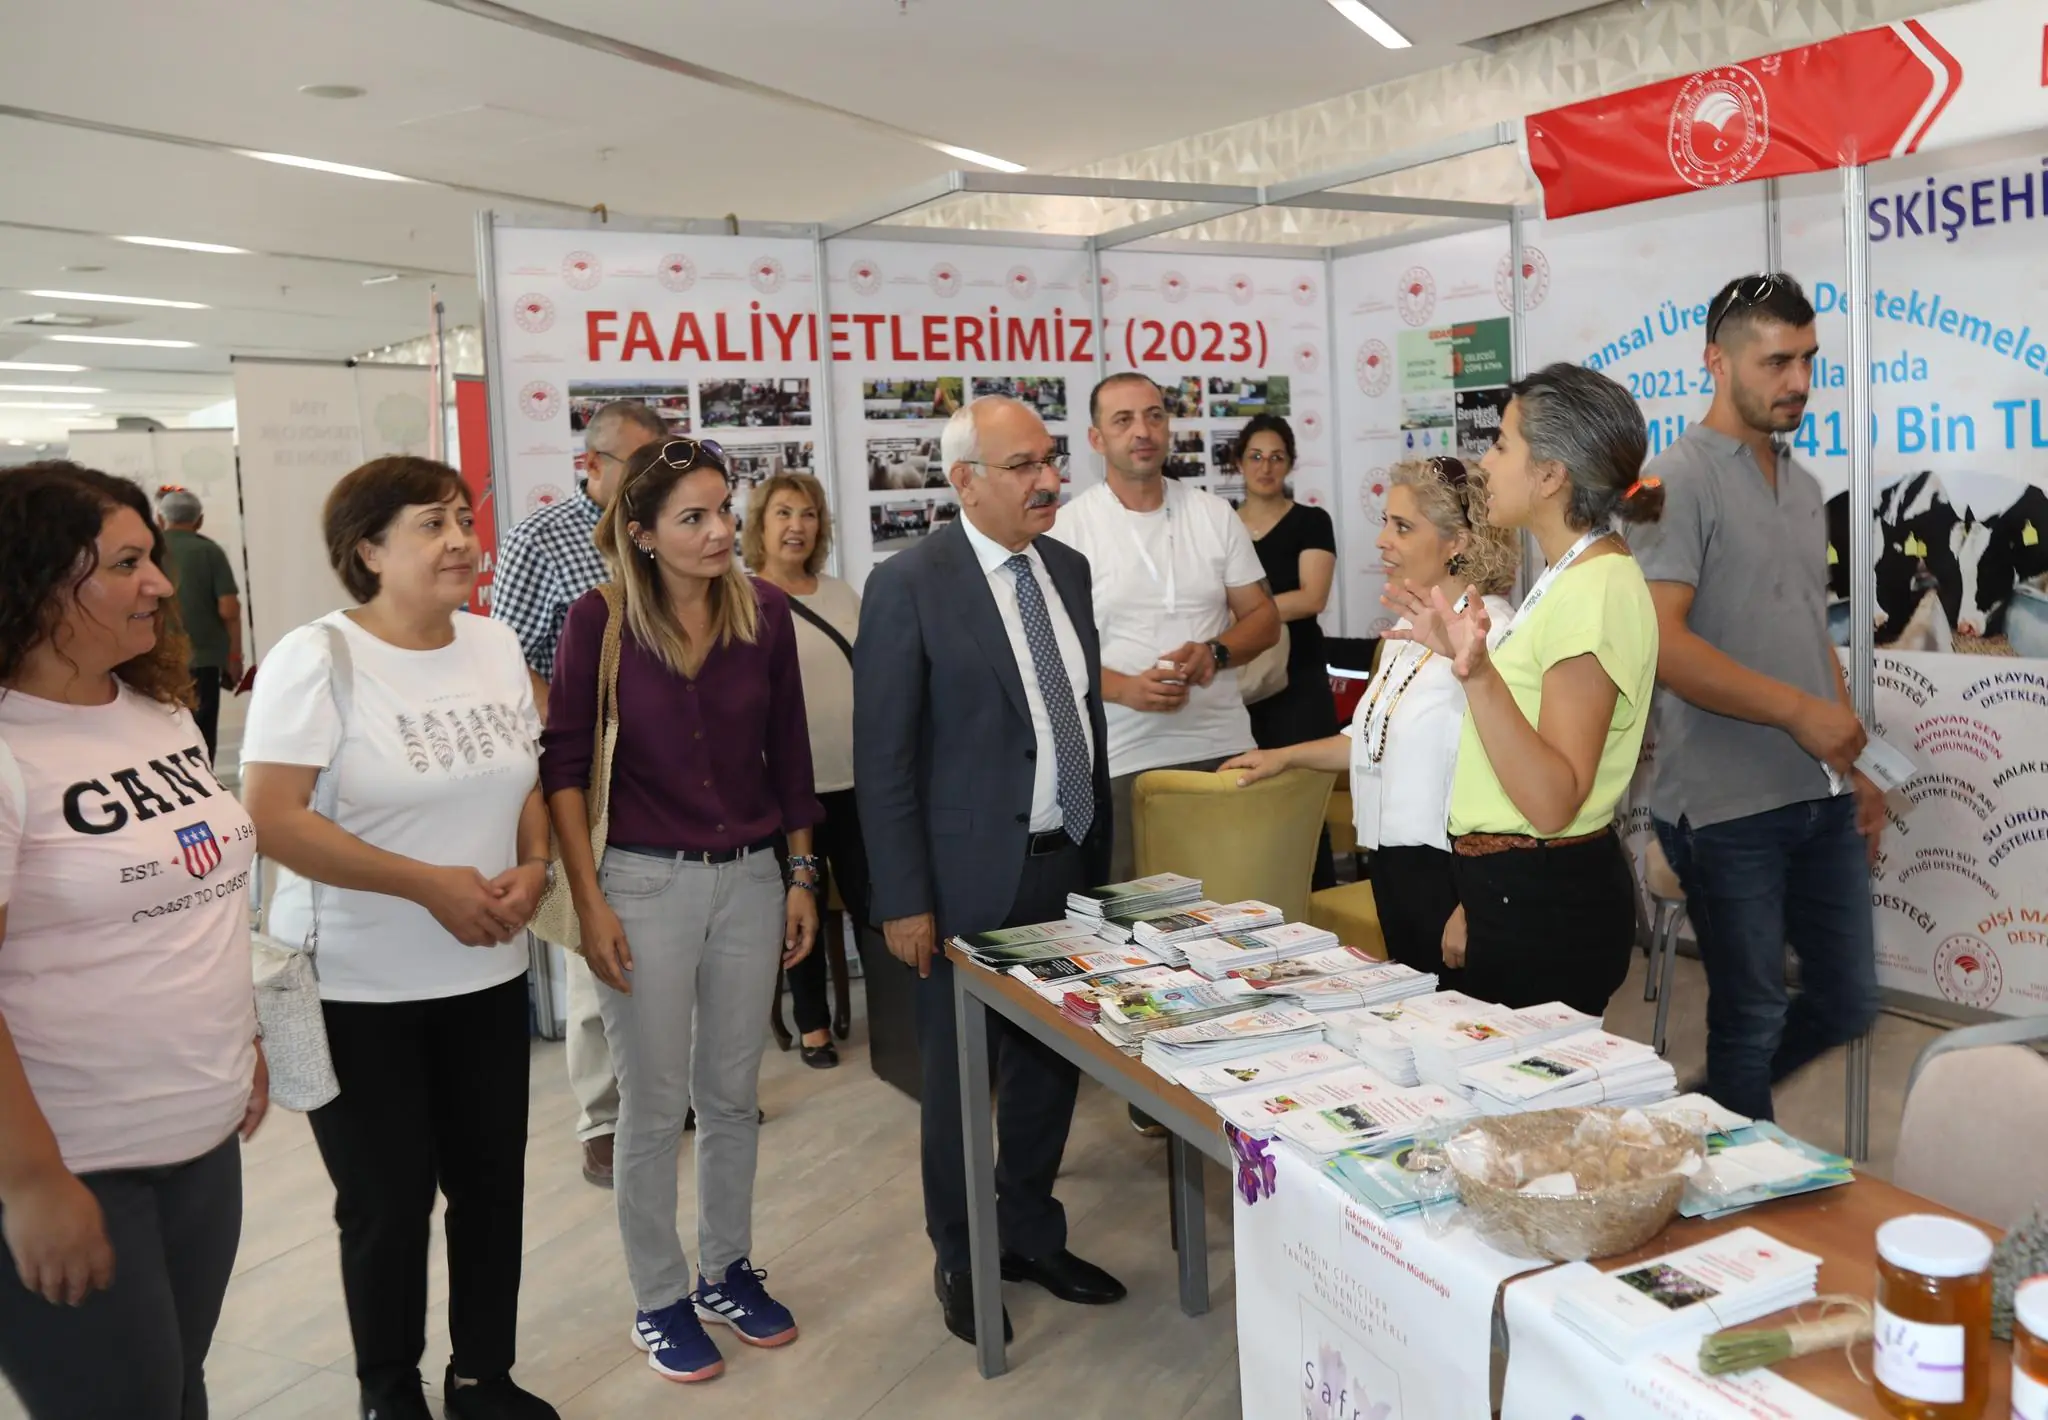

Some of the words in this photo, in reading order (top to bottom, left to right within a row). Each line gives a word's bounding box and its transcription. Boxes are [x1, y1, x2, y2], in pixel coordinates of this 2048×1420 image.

[1868, 157, 2048, 242] SKİŞEHİ
[1659, 298, 1713, 336] Üre
[1125, 318, 1268, 368] (2023)
[1627, 367, 1714, 400] 2021-2
[1896, 402, 1975, 453] Bin
[1993, 398, 2048, 449] TL
[1884, 658, 1938, 698] DESTEK
[1962, 677, 1991, 702] GEN
[1914, 715, 1970, 736] HAYVAN
[1992, 759, 2036, 789] MALAK
[63, 745, 229, 835] GANT
[1982, 824, 2002, 847] SU
[119, 860, 165, 884] EST.
[214, 871, 249, 899] COAST
[1977, 906, 2015, 936] DİŞİ
[1344, 1204, 1377, 1233] Eskişehir
[1379, 1245, 1406, 1270] Orman
